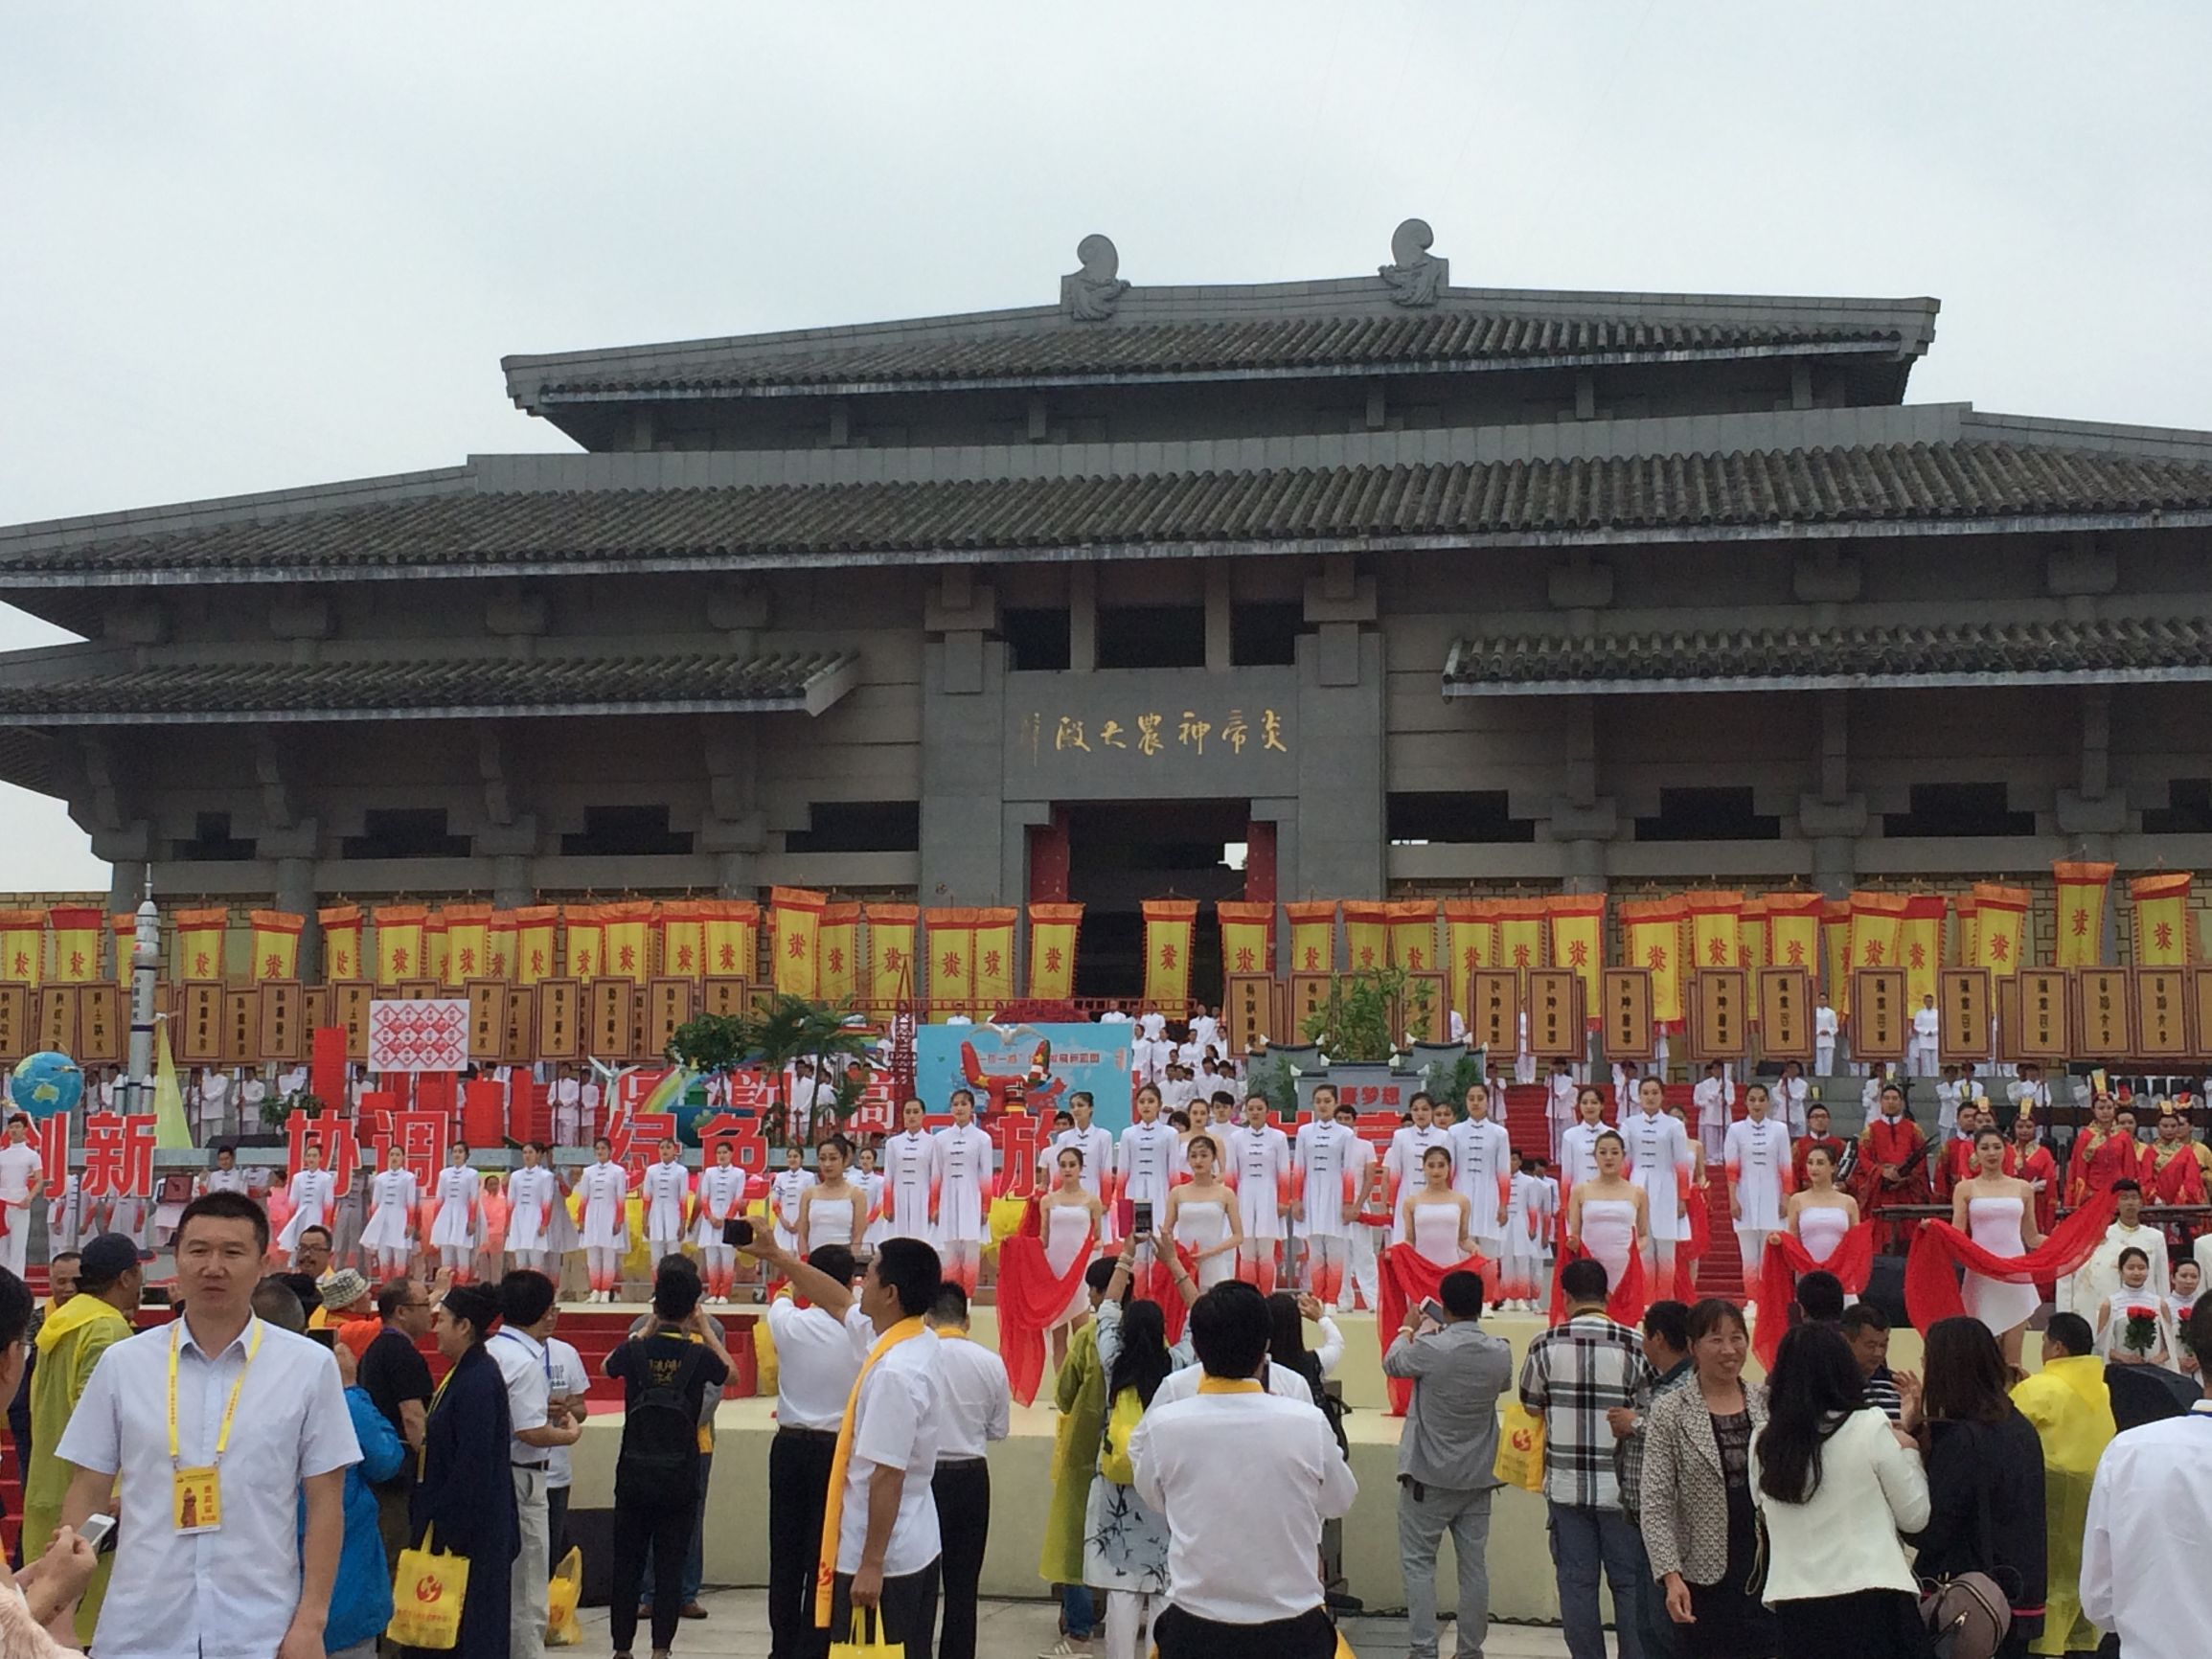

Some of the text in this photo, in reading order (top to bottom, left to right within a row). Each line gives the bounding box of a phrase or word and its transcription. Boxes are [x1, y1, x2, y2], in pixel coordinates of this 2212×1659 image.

[285, 1109, 449, 1198] 协调
[605, 1109, 770, 1200] 绿色
[920, 1108, 1060, 1200] 放
